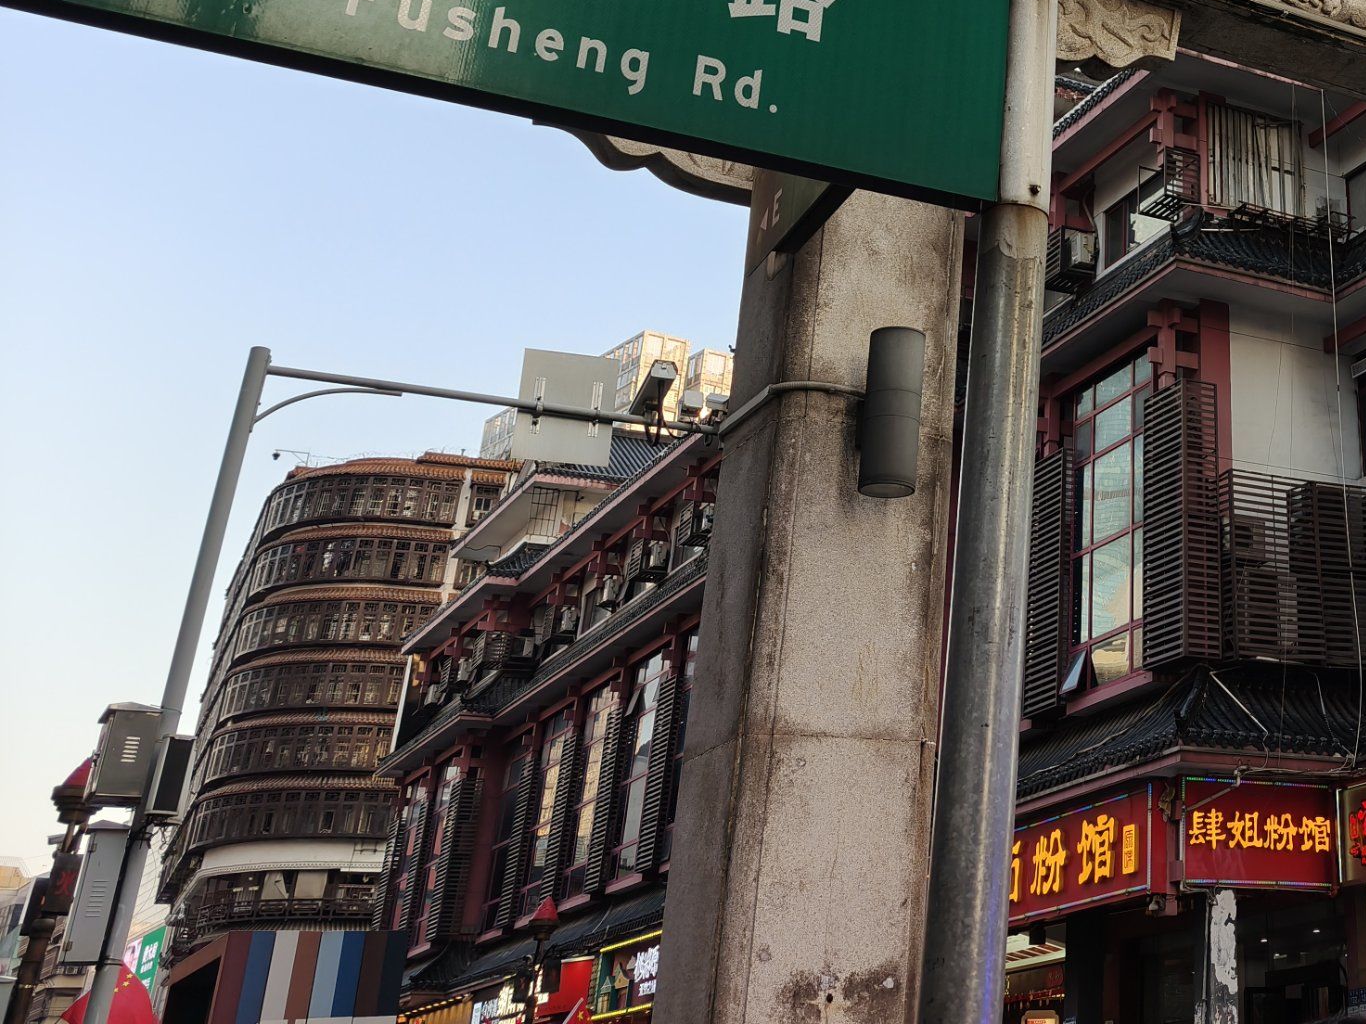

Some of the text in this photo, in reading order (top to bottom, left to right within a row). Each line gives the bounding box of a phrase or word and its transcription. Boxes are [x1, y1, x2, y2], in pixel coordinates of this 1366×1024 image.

[692, 54, 779, 116] Rd.
[771, 187, 783, 228] E
[1187, 809, 1331, 853] 肆姐粉馆
